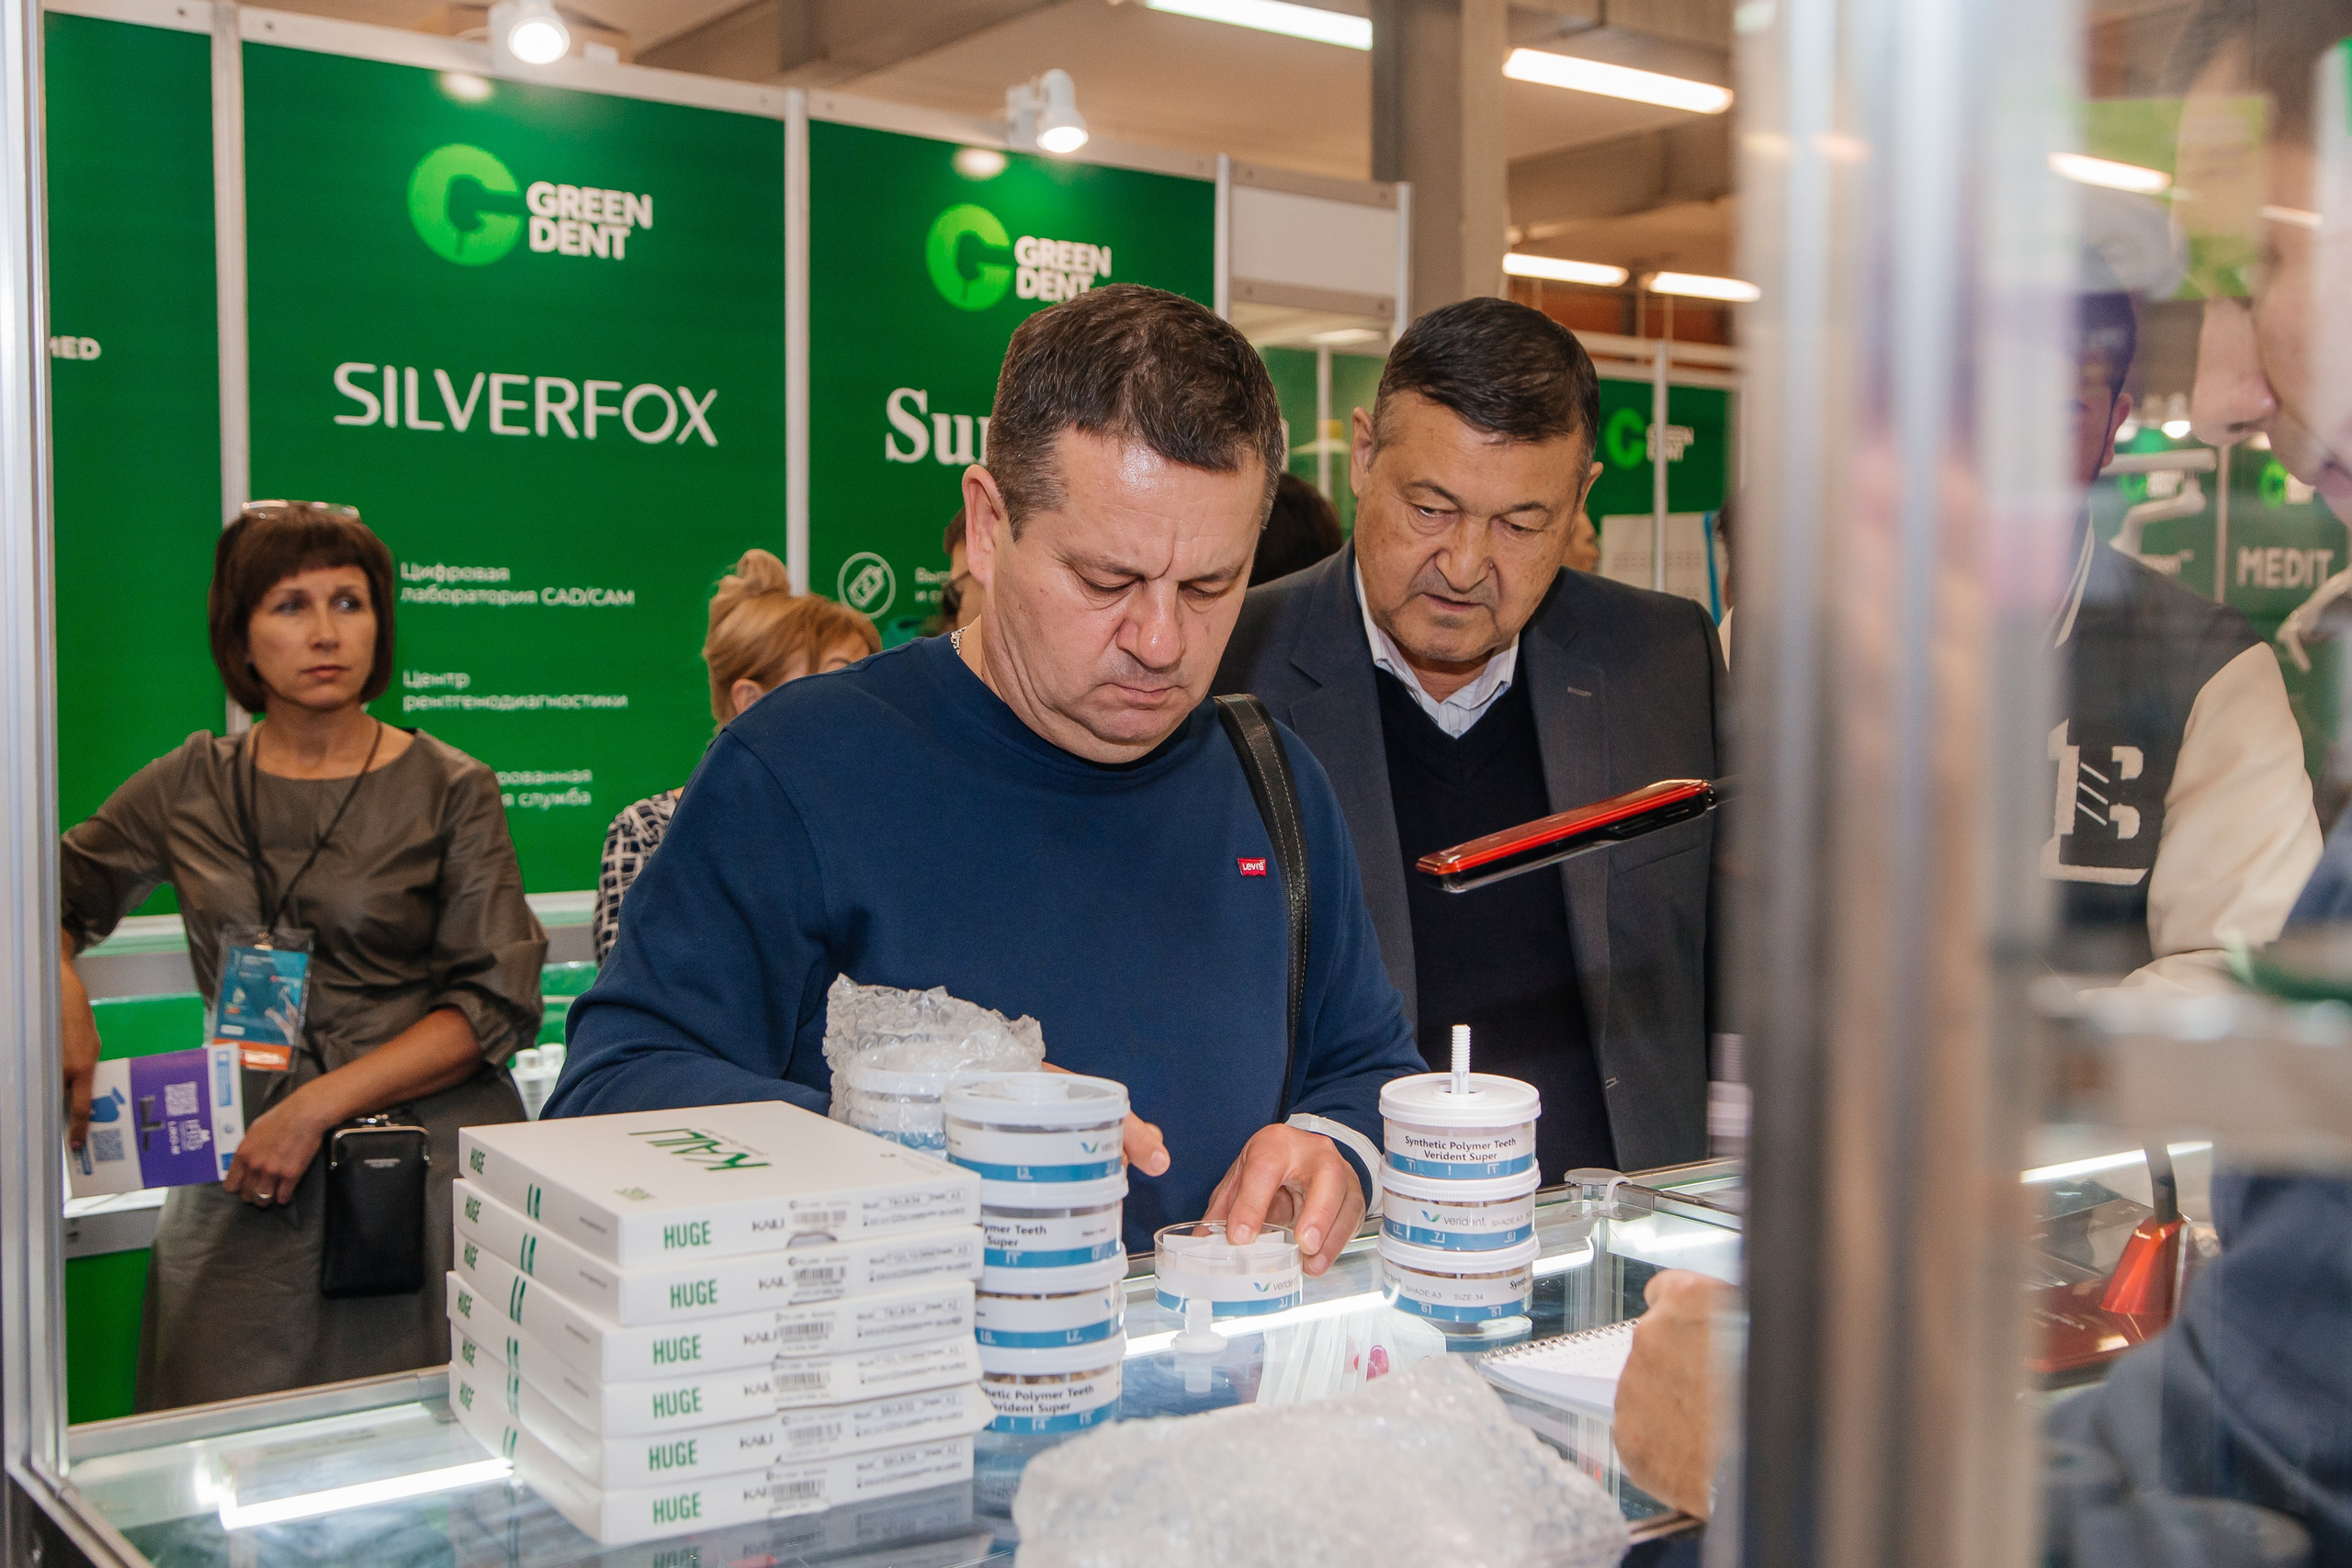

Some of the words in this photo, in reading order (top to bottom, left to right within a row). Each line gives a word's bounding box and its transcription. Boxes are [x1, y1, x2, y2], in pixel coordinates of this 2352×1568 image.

[526, 181, 652, 229] GREEN
[528, 217, 630, 260] DENT
[1014, 235, 1112, 278] GREEN
[1016, 266, 1095, 302] DENT
[334, 362, 718, 446] SILVERFOX
[401, 561, 510, 583] Цифровая
[2236, 547, 2335, 589] MEDIT
[400, 584, 538, 607] лаборатория
[540, 586, 636, 607] CAD/CAM
[402, 670, 471, 690] Центр
[402, 694, 628, 714] рентгенодиагностики
[1405, 1135, 1447, 1149] Synthetic
[1450, 1141, 1491, 1152] Polymer
[1494, 1138, 1517, 1148] Teeth
[1424, 1150, 1466, 1161] Verident
[1469, 1152, 1498, 1163] Super
[663, 1220, 712, 1250] HUGE
[1015, 1225, 1046, 1235] Teeth
[1492, 1217, 1515, 1227] SHADE
[987, 1236, 1018, 1248] Super
[670, 1279, 718, 1309] HUGE
[1406, 1285, 1430, 1298] SHADE
[1453, 1293, 1472, 1302] SIZE
[653, 1334, 702, 1365] HUGE
[652, 1387, 703, 1418] HUGE
[1015, 1390, 1063, 1403] Polymer
[1067, 1385, 1094, 1397] Teeth
[991, 1401, 1034, 1413] erident
[1038, 1403, 1070, 1415] Super
[649, 1438, 698, 1471] HUGE
[652, 1491, 703, 1524] HUGE
